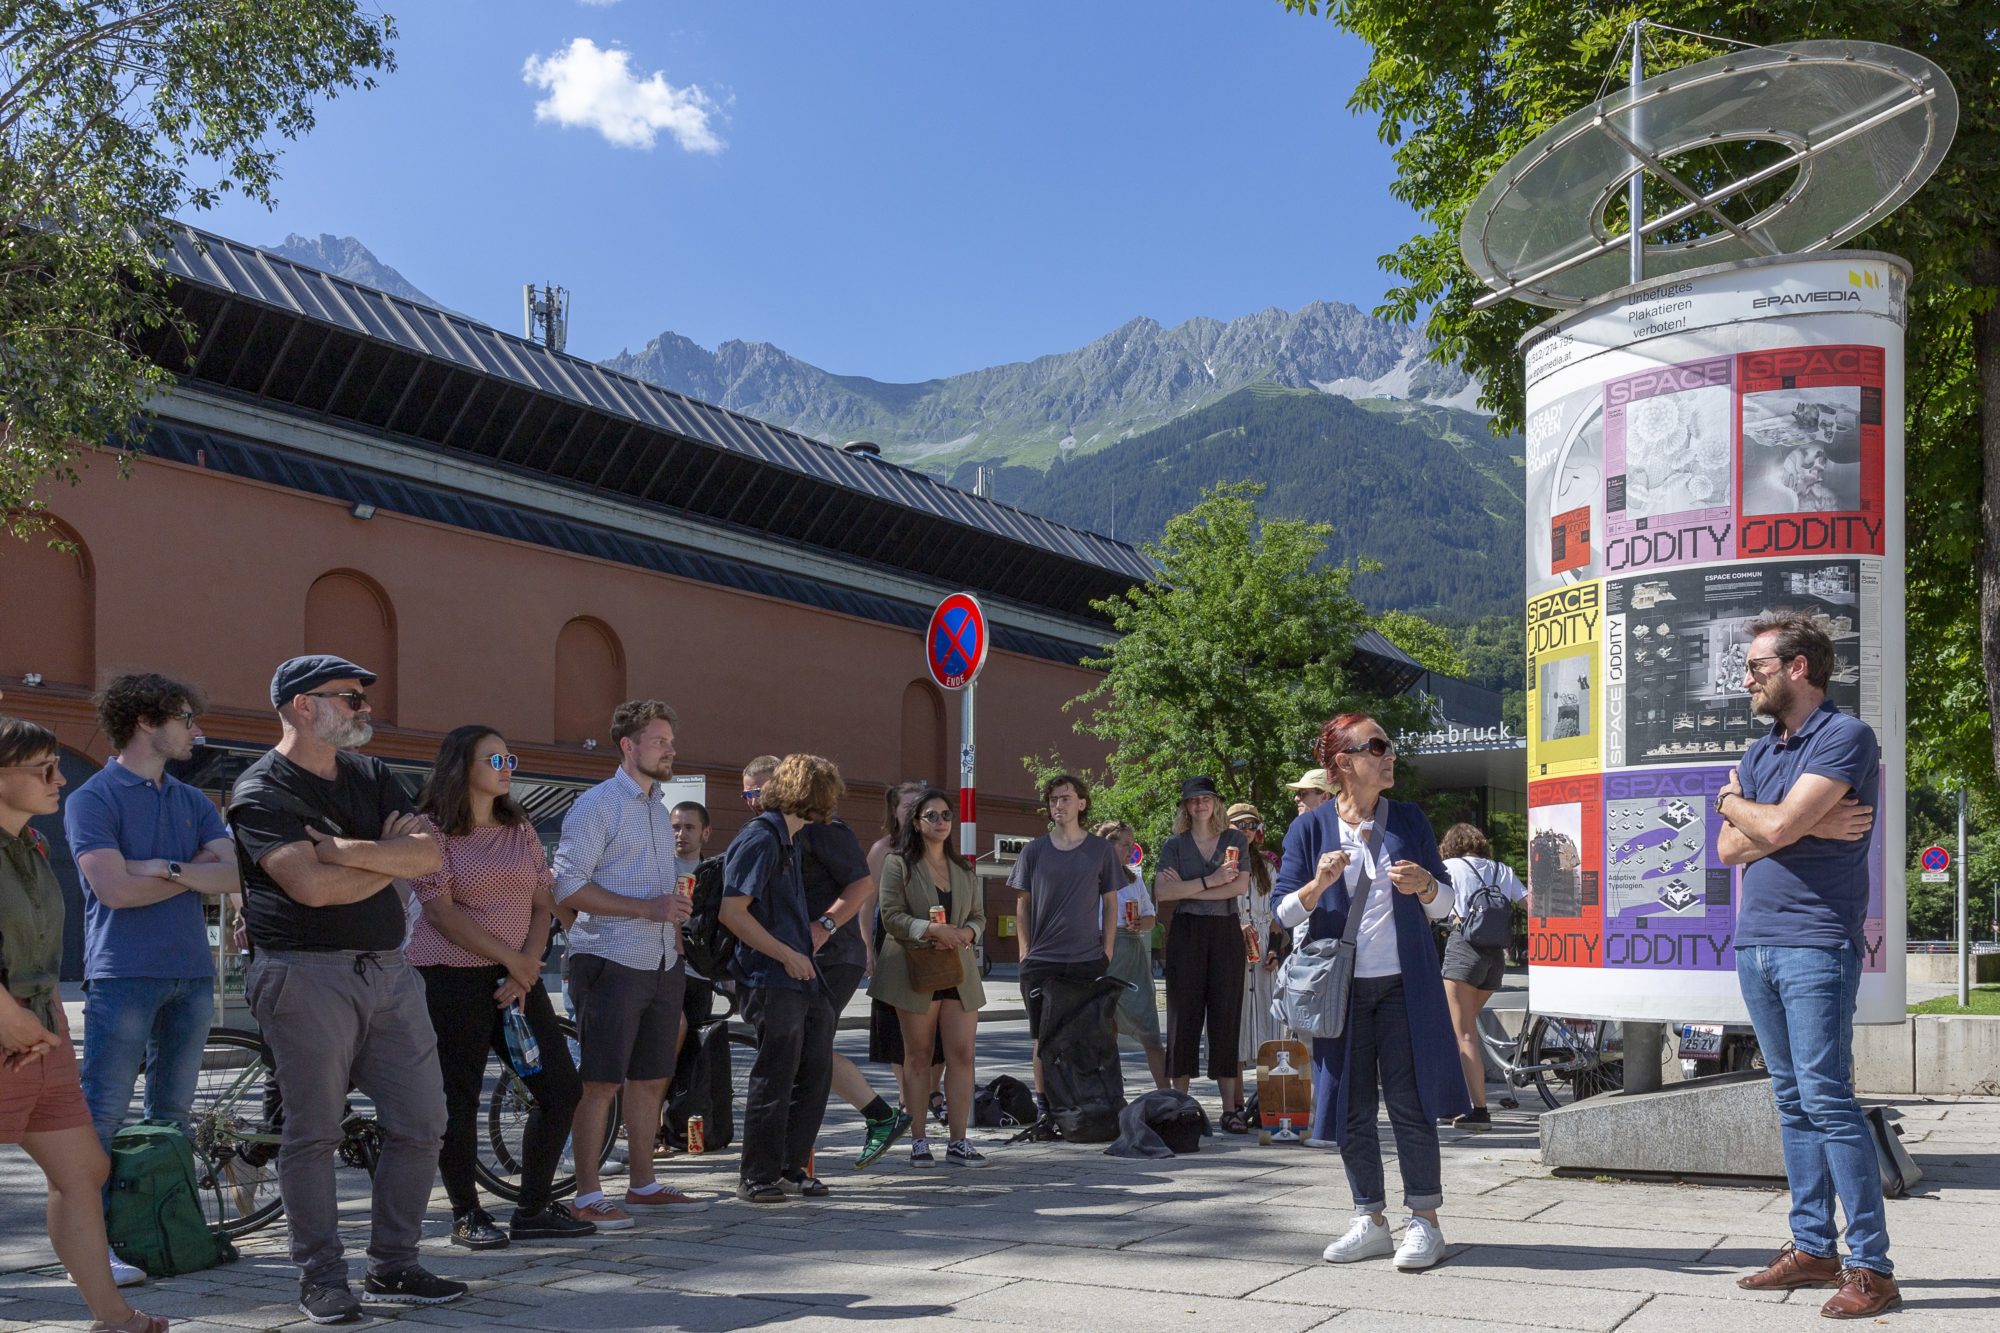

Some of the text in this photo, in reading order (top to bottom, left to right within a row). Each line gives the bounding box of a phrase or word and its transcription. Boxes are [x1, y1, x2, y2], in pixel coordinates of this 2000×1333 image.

[1628, 282, 1693, 306] Unbefugtes
[1752, 291, 1861, 309] EPAMEDIA
[1628, 300, 1692, 323] Plakatieren
[1633, 315, 1686, 338] verboten!
[1746, 350, 1880, 379] SPACE
[1610, 362, 1727, 405] SPACE
[1606, 523, 1731, 571] ODDITY
[1742, 516, 1882, 553] ODDITY
[1704, 571, 1763, 582] ESPACE COMMUN
[1528, 586, 1596, 624] SPACE
[1528, 609, 1599, 656] ODDITY
[1610, 620, 1623, 680] ODDITY
[946, 673, 965, 687] ENDE
[1610, 687, 1622, 764] SPACE
[1530, 780, 1595, 804] SPACE
[1610, 772, 1728, 799] SPACE
[1608, 873, 1637, 883] Adaptive
[1608, 882, 1645, 891] Typologien.
[1530, 932, 1599, 963] ODDITY
[1606, 933, 1731, 967] ODDITY
[1685, 1039, 1698, 1050] 25
